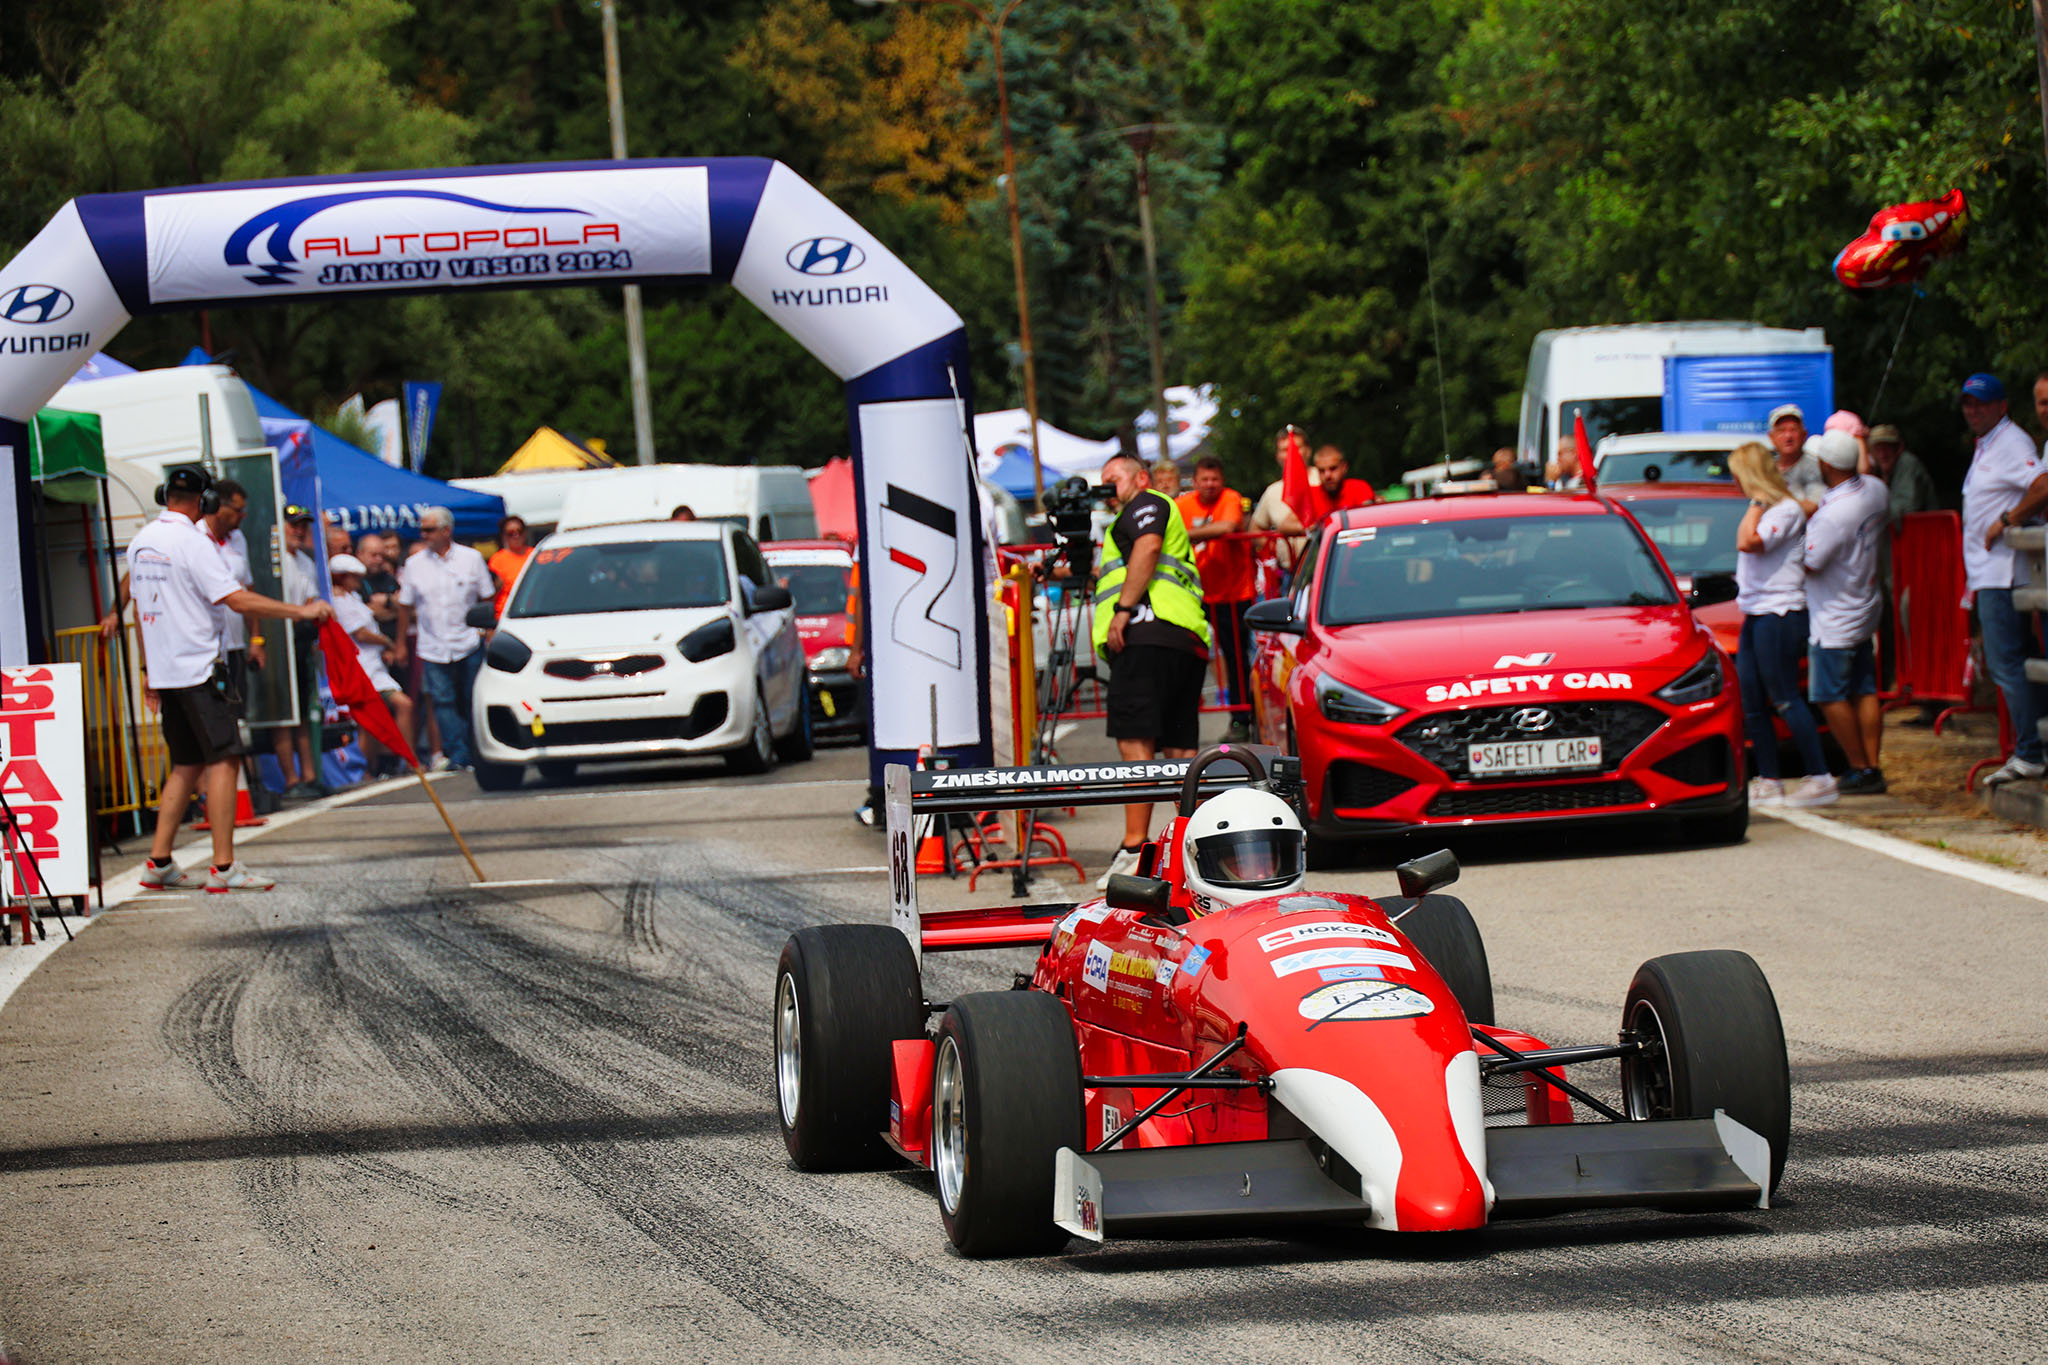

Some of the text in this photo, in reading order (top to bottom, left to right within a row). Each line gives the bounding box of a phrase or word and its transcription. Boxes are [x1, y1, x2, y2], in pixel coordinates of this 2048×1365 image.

[304, 223, 620, 259] AUTOPOLA
[318, 250, 633, 285] JANKOV VRSOK 2024
[772, 285, 888, 306] HYUNDAI
[0, 331, 90, 354] YUNDAI
[1425, 672, 1633, 703] SAFETY CAR
[1483, 740, 1588, 769] SAFETY CAR
[931, 762, 1206, 788] ZMEŠKALMOTORSPO
[893, 831, 910, 907] 68
[1298, 926, 1388, 939] HOKCAR
